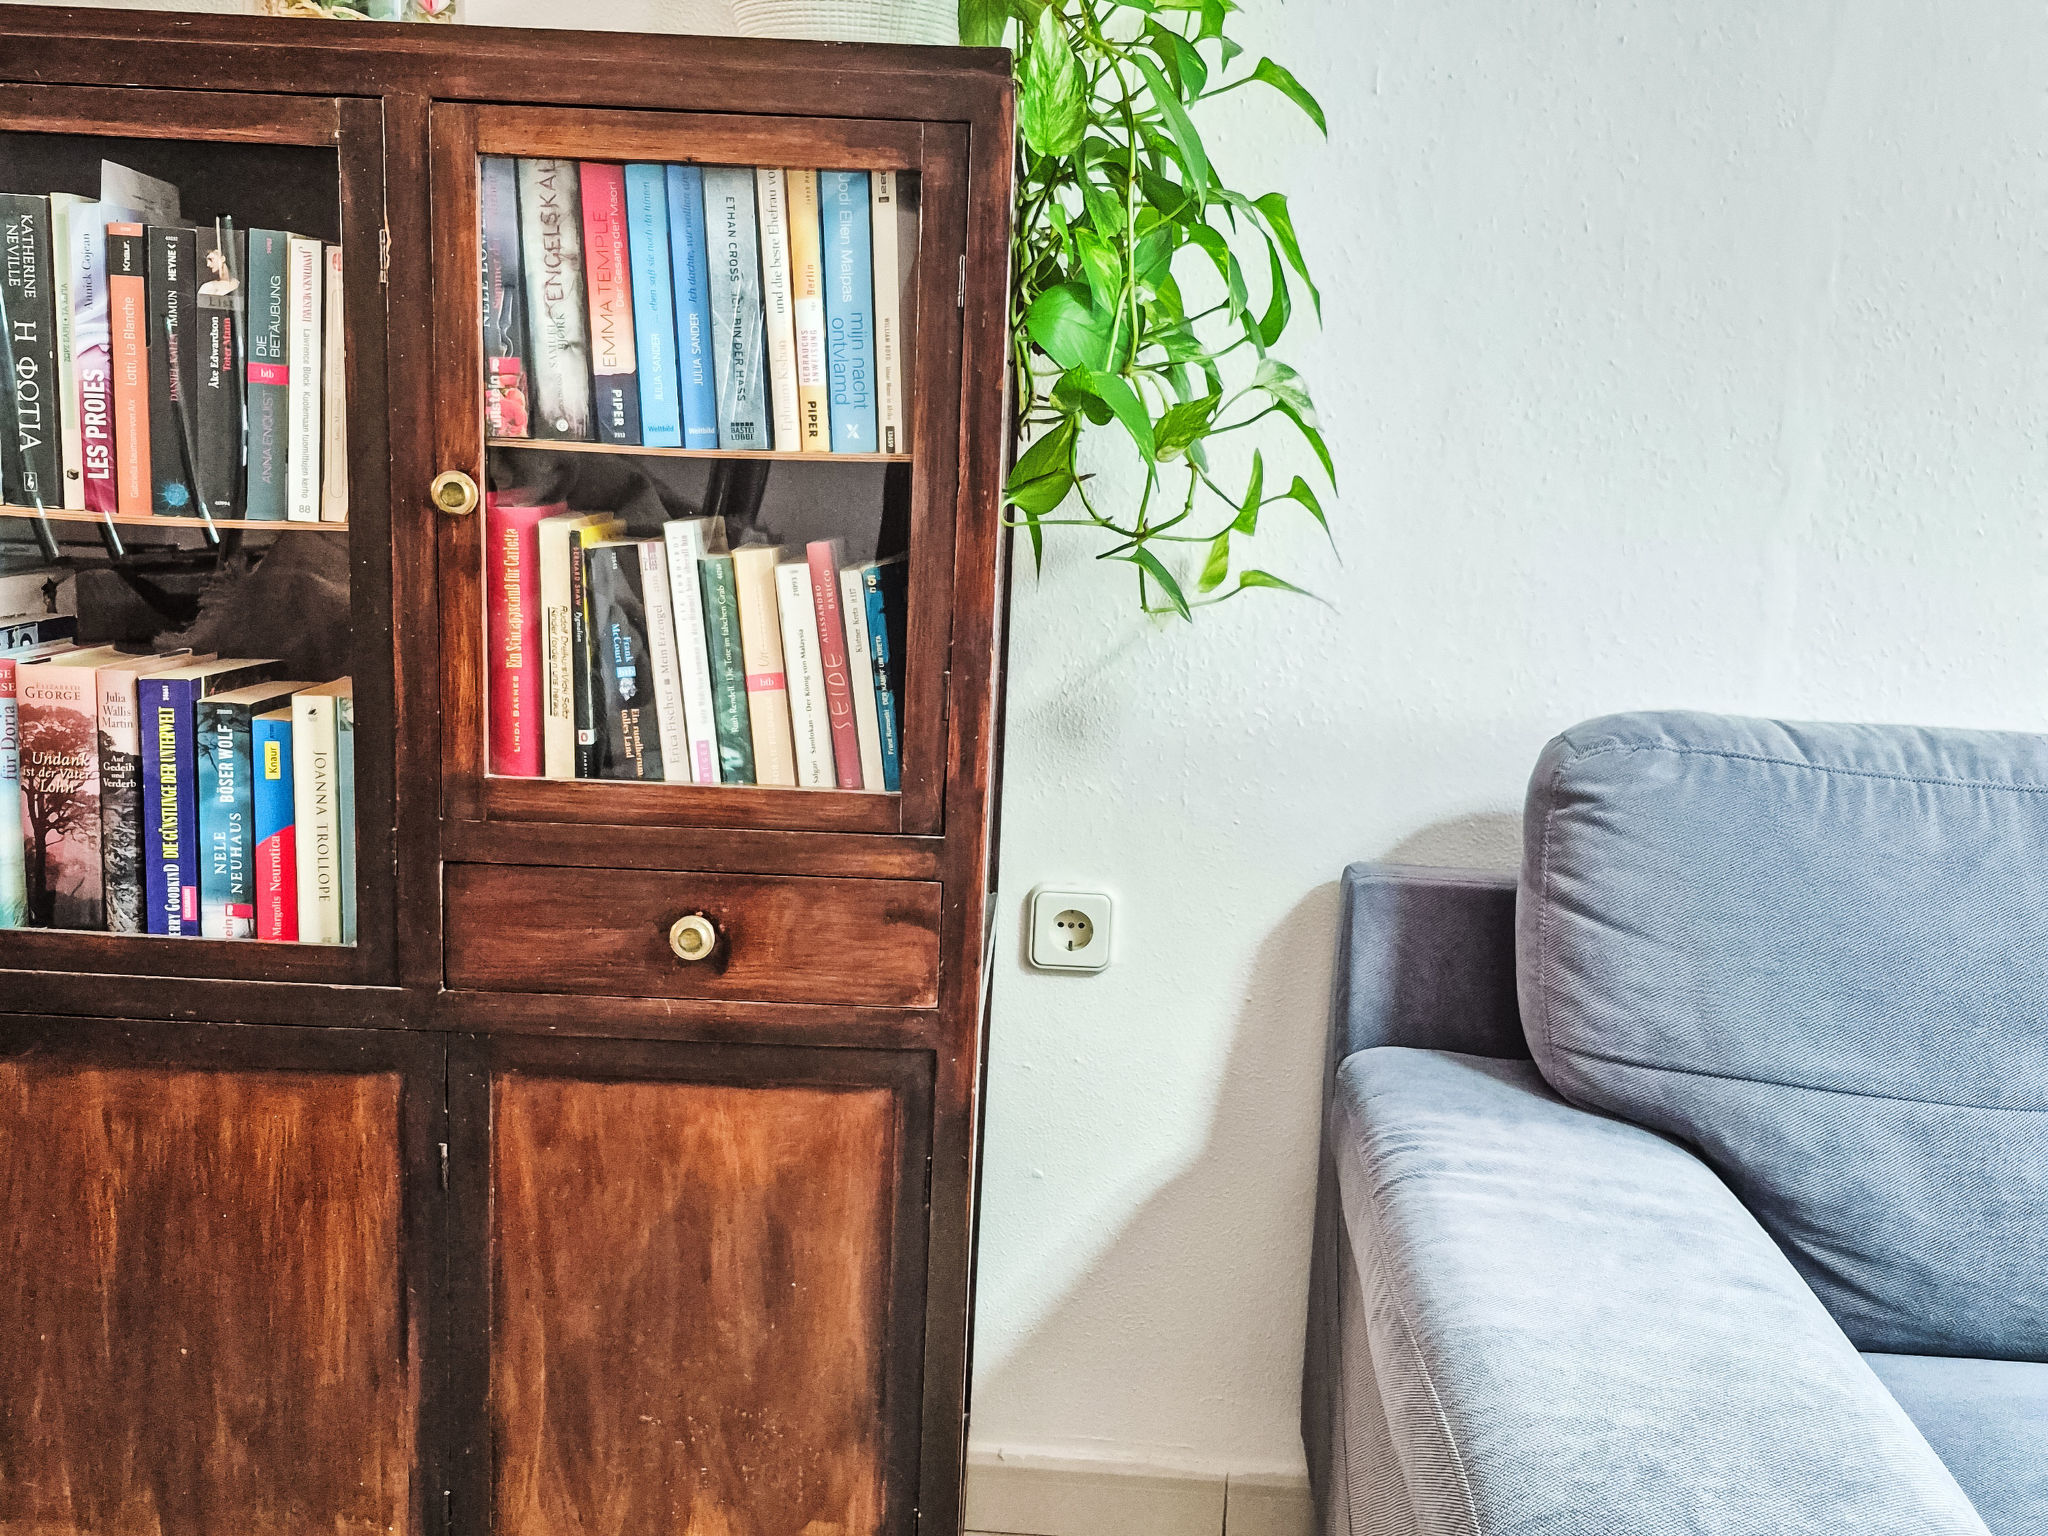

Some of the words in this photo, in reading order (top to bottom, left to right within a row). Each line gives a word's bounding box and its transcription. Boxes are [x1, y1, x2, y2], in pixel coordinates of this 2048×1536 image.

[608, 181, 619, 217] Maori
[838, 172, 851, 206] Jodi
[643, 214, 652, 227] da
[725, 196, 737, 238] ETHAN
[766, 189, 780, 235] Ehefrau
[839, 210, 853, 245] Ellen
[538, 160, 565, 301] ENGELSKAL
[610, 219, 621, 239] der
[644, 229, 655, 252] noch
[685, 231, 694, 247] wir
[6, 225, 21, 287] NEVILLE
[21, 214, 37, 298] KATHERINE
[81, 233, 94, 270] Cojean
[167, 249, 177, 281] HEYNE
[592, 210, 613, 296] TEMPLE
[613, 240, 624, 284] Gesang
[646, 255, 655, 267] sie
[728, 242, 740, 282] CROSS
[769, 238, 782, 268] beste
[83, 272, 94, 310] Annick
[770, 270, 783, 289] die
[805, 264, 816, 296] Berlin
[840, 249, 855, 303] Malpas
[167, 290, 178, 327] IMMUN
[616, 287, 625, 308] Der
[687, 287, 698, 304] Ich
[772, 291, 785, 314] und
[122, 297, 136, 339] Blanche
[222, 317, 231, 345] Mann
[269, 275, 281, 358] BETÄUBUNG
[733, 317, 742, 339] BIN
[847, 312, 868, 350] mijn
[210, 316, 219, 368] Edwardson
[256, 335, 267, 357] DIE
[302, 328, 312, 364] Lawrence
[546, 323, 558, 369] SAMUEL
[600, 300, 617, 367] EMMA
[689, 312, 702, 355] SANDER
[124, 343, 136, 356] La
[222, 347, 232, 371] Toter
[650, 333, 662, 373] SANDER
[734, 342, 744, 366] DER
[800, 329, 810, 384] GEBRAUCHS
[809, 329, 820, 384] ANWEISUNG
[831, 317, 851, 406] ontvlamd
[124, 360, 138, 386] Lotti,
[169, 368, 179, 402] DANIEL
[208, 370, 219, 389] Åke
[260, 368, 274, 379] btb
[302, 367, 312, 387] Block
[653, 374, 665, 400] JULIA
[693, 358, 703, 386] JULIA
[736, 370, 746, 402] HASS
[852, 357, 869, 410] nacht
[16, 356, 42, 452] ΦΩΤΙΑ
[82, 368, 108, 439] PROIES
[262, 390, 274, 446] ENQUIST
[302, 391, 312, 433] Kuolemaan
[611, 389, 625, 427] PIPER
[807, 400, 819, 438] PIPER
[688, 427, 715, 435] Weltbild
[86, 444, 110, 479] LES
[261, 447, 273, 484] ANNA
[301, 477, 311, 499] kerho
[298, 504, 311, 514] 88
[503, 528, 520, 566] Carlotta
[503, 568, 521, 582] für
[573, 546, 581, 581] BERNARD
[574, 583, 582, 606] SHAW
[717, 584, 727, 605] Grab
[823, 569, 836, 610] BARICCO
[551, 607, 559, 635] Kinder
[573, 611, 584, 643] Pygmalion
[652, 604, 667, 647] Erzengel
[719, 606, 731, 637] falschen
[815, 585, 829, 643] ALESSANDRO
[851, 607, 860, 625] Kreta
[611, 623, 623, 664] McCourt
[623, 636, 634, 662] Frank
[722, 637, 730, 647] im
[723, 648, 733, 667] Tote
[798, 629, 808, 659] Malaysia
[875, 635, 884, 656] KRETA
[505, 652, 523, 669] Ein
[659, 651, 671, 675] Mein
[726, 667, 734, 681] Die
[878, 656, 886, 668] UM
[25, 686, 81, 701] GEORGE
[512, 675, 520, 718] BARNES
[759, 677, 775, 687] btb
[802, 674, 811, 696] König
[825, 653, 852, 729] SEIDE
[103, 704, 131, 717] Wallis
[105, 691, 126, 705] Julia
[663, 691, 677, 732] Fischer
[727, 685, 737, 715] Rendell
[881, 692, 889, 706] DER
[1, 704, 18, 751] Doria
[102, 717, 134, 729] Martin
[621, 709, 632, 735] tolles
[631, 708, 640, 723] Ein
[157, 705, 177, 763] UNTERWELT
[217, 724, 234, 760] WOLF
[513, 722, 521, 753] LINDA
[624, 736, 636, 759] Land
[808, 719, 817, 755] Sandokan
[32, 751, 90, 768] Undank
[111, 755, 125, 763] Auf
[268, 747, 278, 774] Knaur
[633, 725, 645, 778] rundherum
[669, 735, 682, 765] Erica
[2, 755, 18, 782] für
[23, 767, 35, 778] ist
[38, 766, 57, 779] der
[103, 762, 135, 772] Gedeih
[111, 771, 125, 779] und
[159, 763, 177, 784] DER
[216, 762, 235, 803] BÖSER
[811, 760, 820, 784] Salgari
[39, 778, 76, 795] Lohn
[103, 778, 137, 788] Verderb
[313, 751, 328, 816] JOANNA
[158, 784, 179, 842] GÜNSTLINGE
[162, 841, 179, 859] DIE
[213, 831, 227, 875] NELE
[229, 812, 243, 894] NEUHAUS
[269, 835, 282, 892] Neurotica
[316, 823, 331, 903] TROLLOPE
[168, 913, 181, 937] ERRY
[271, 895, 284, 936] Margolis
